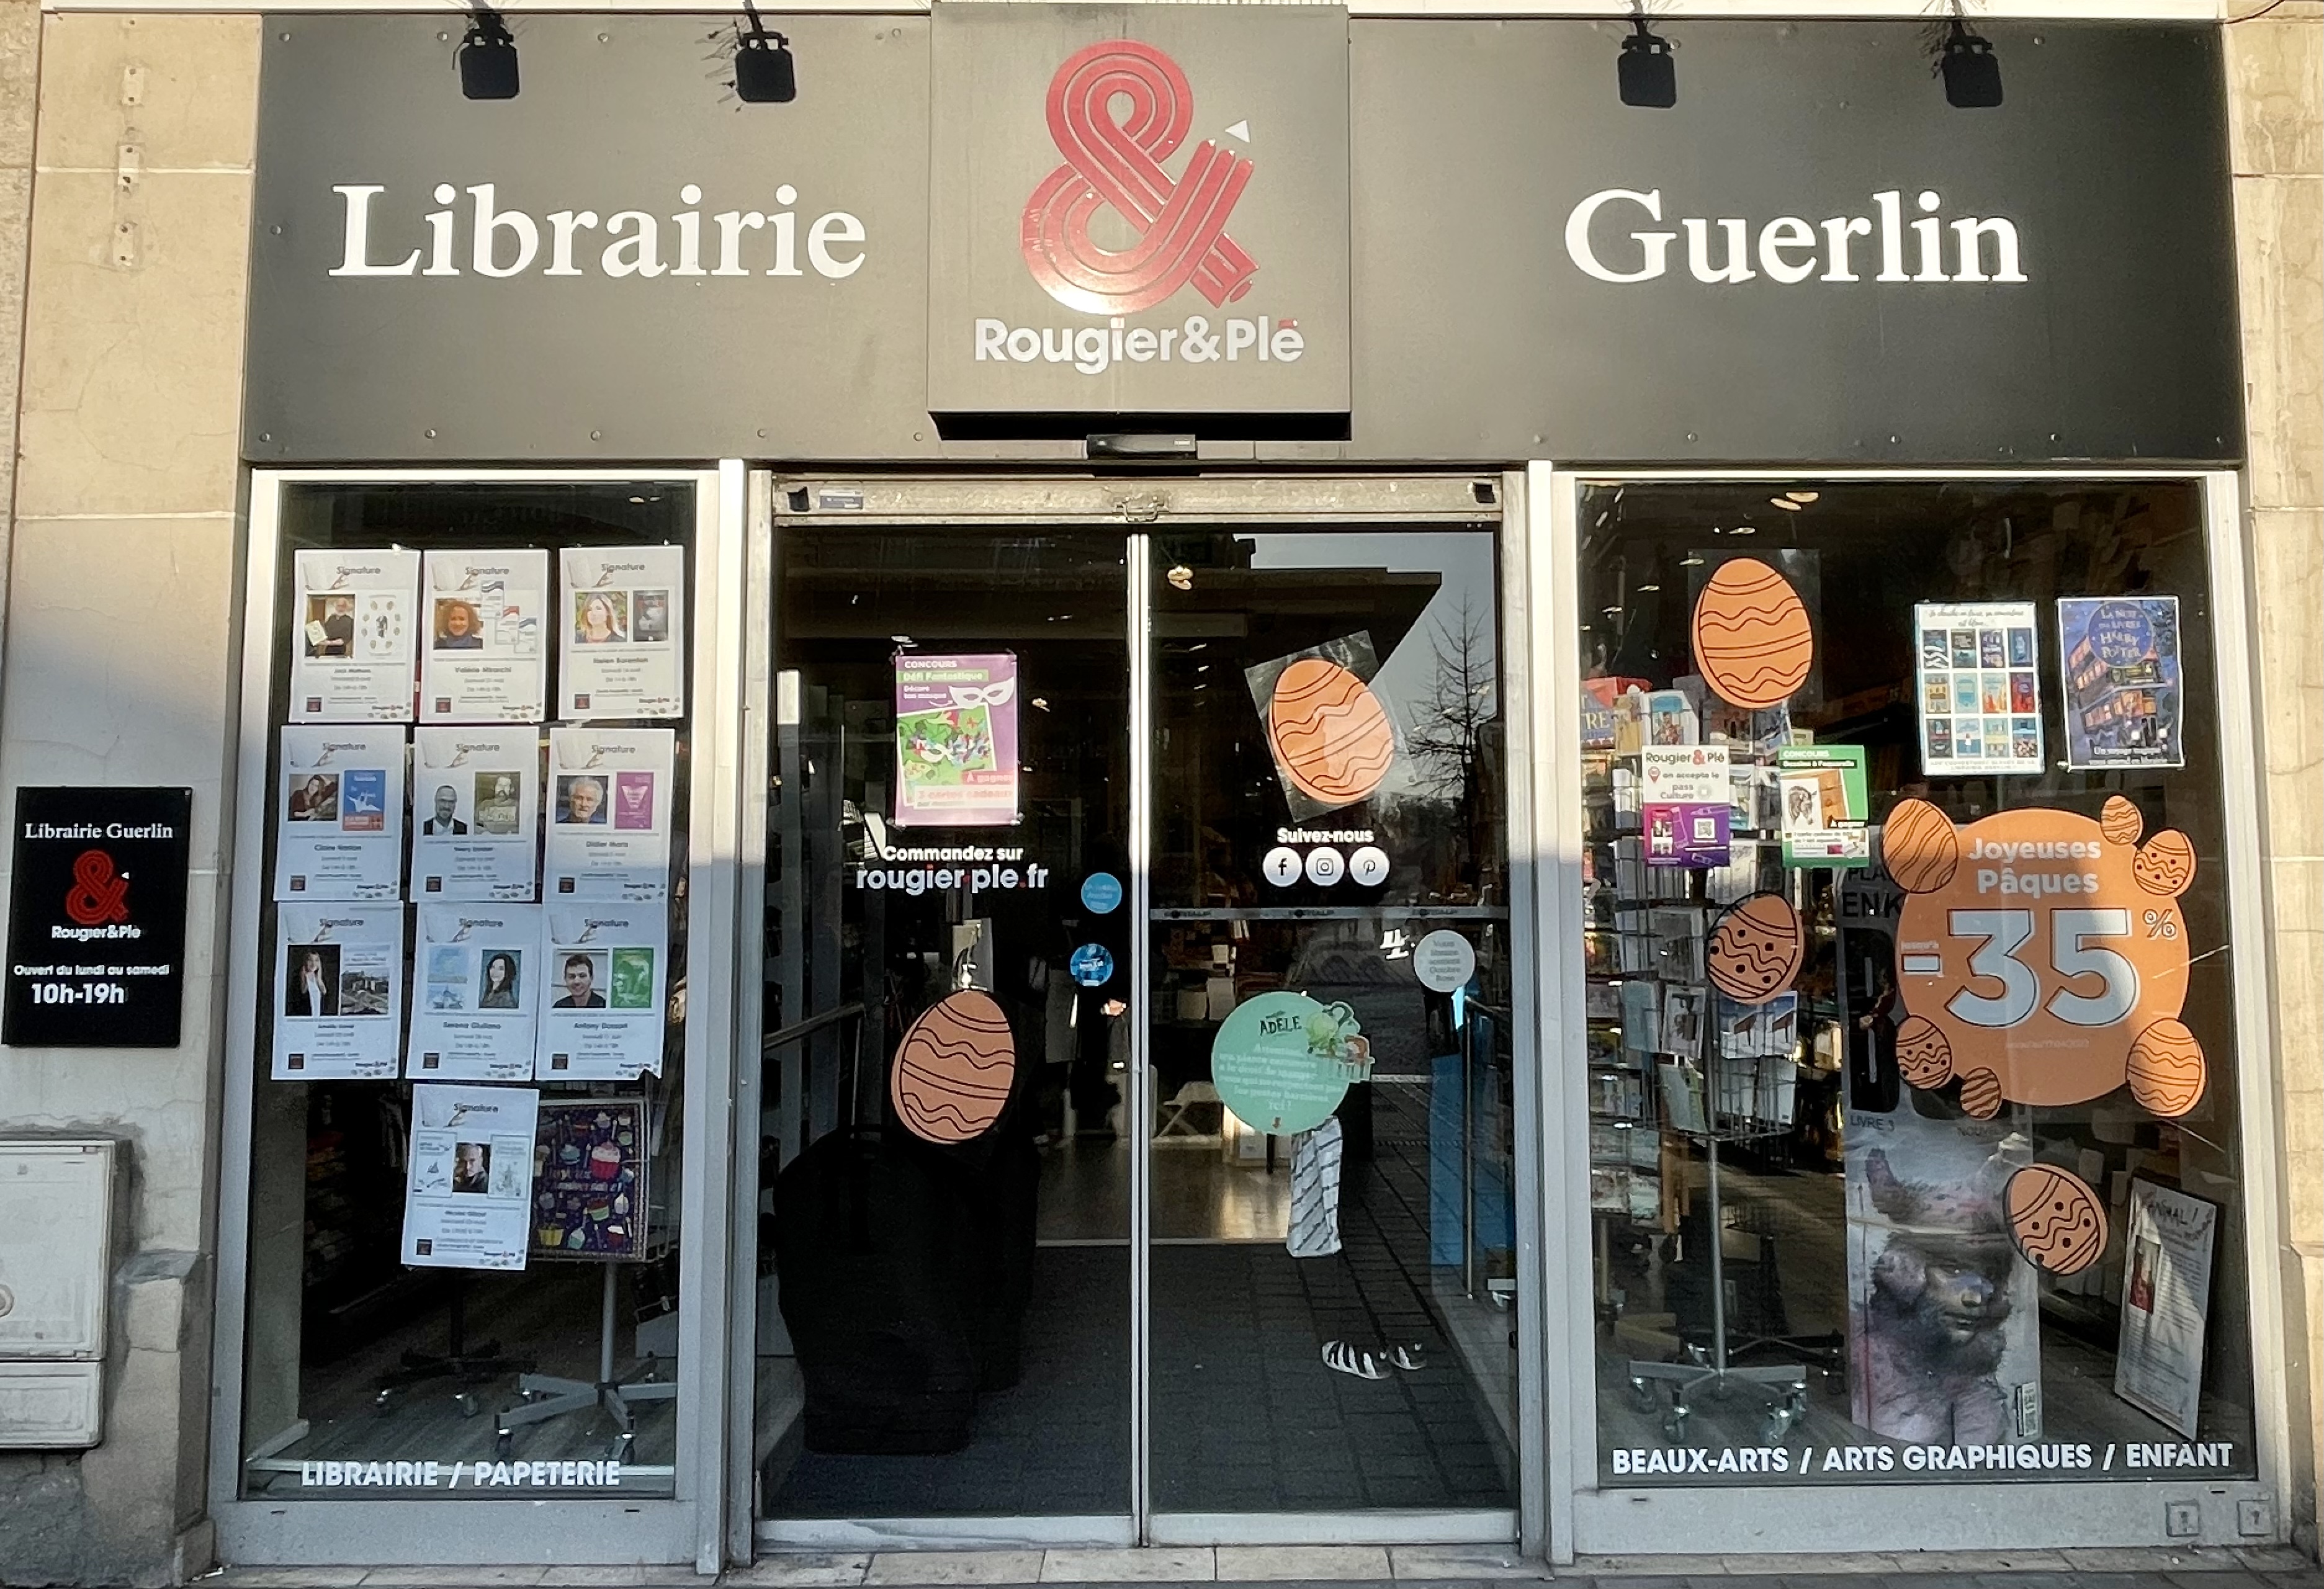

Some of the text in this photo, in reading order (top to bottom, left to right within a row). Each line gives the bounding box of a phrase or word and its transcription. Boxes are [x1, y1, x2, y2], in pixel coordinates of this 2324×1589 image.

[327, 182, 867, 279] Librairie
[1564, 188, 2029, 284] Guerlin
[974, 315, 1305, 375] Rougier&Plé
[336, 565, 381, 576] Signature
[465, 566, 509, 576] Signature
[601, 563, 645, 573] Signature
[2101, 646, 2142, 658] POTTER
[904, 660, 958, 669] CONCOURS
[904, 672, 983, 681] Défi Fantastique
[322, 742, 366, 753] Signature
[455, 743, 500, 753] Signature
[591, 745, 635, 754] Signature
[1646, 749, 1725, 765] Rougier & Plé
[1783, 750, 1830, 758] CONCOURS
[1672, 784, 1694, 794] pass
[24, 823, 173, 839] Librairie Guerlin
[1277, 828, 1374, 844] Suivez-nous
[884, 846, 1023, 862] Commandez sur
[1968, 838, 2102, 863] Joyeuses
[1848, 865, 1887, 881] PLA
[1977, 867, 2099, 898] Pâques
[1842, 892, 1905, 918] ENK
[319, 918, 364, 929] Signature
[459, 918, 503, 929] Signature
[583, 918, 629, 929] Signature
[14, 964, 170, 976] Ouvert du lundi au samedi
[31, 983, 125, 1004] 10h-19h
[454, 1103, 498, 1113] Signature
[1850, 1114, 1895, 1132] LIVRE 3
[1612, 1441, 2233, 1475] BEAUX-ARTS / ARTS GRAPHIQUES / ENFANT
[300, 1460, 621, 1489] LIBRAIRIE / PAPETERIE
